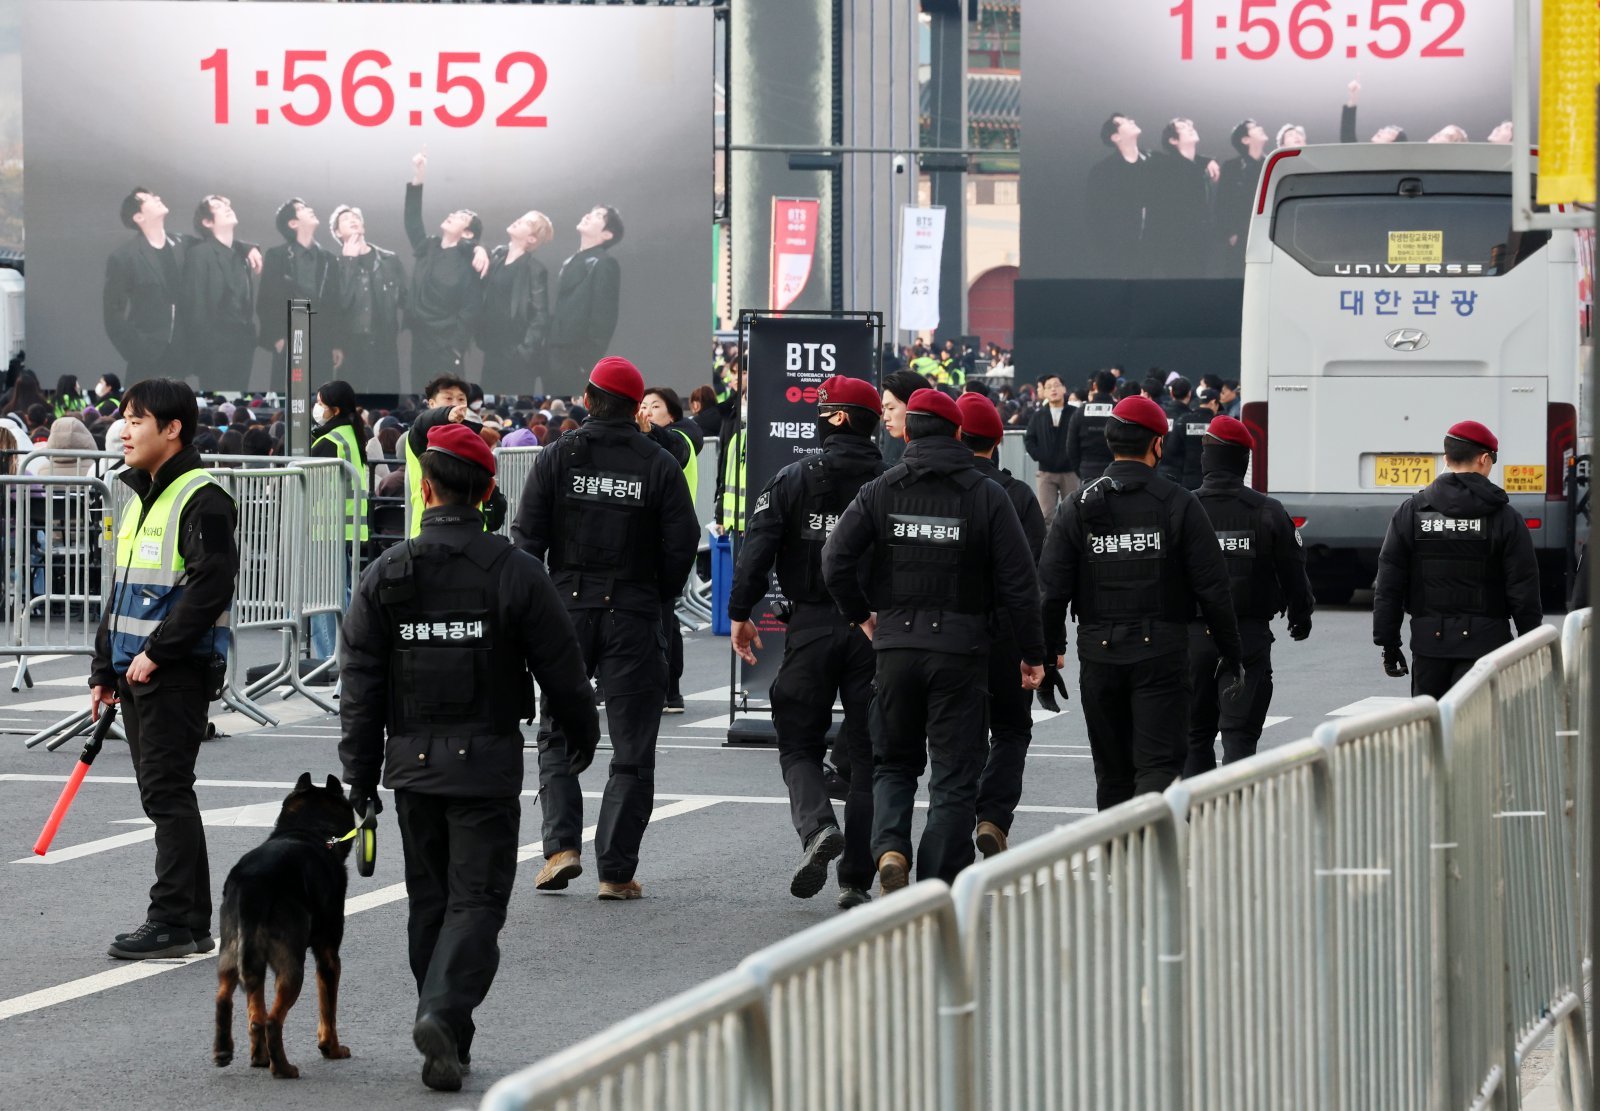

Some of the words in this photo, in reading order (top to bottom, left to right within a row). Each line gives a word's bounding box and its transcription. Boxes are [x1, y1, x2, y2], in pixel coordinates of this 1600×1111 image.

[1170, 0, 1466, 60] 1:56:52
[200, 48, 548, 128] 1:56:52
[787, 208, 807, 222] BTS
[915, 216, 933, 227] BTS
[1334, 264, 1483, 274] UNIVERSE
[1340, 289, 1478, 317] 대한관광
[786, 342, 837, 372] BTS
[769, 421, 817, 439] 재입장
[793, 445, 824, 455] Re-entr
[572, 475, 643, 500] 경찰특공대
[893, 522, 960, 541] 경찰특공대
[1420, 518, 1482, 533] 경찰특공대
[1091, 532, 1161, 554] 경찰특공대
[399, 621, 484, 641] 경찰특공대
